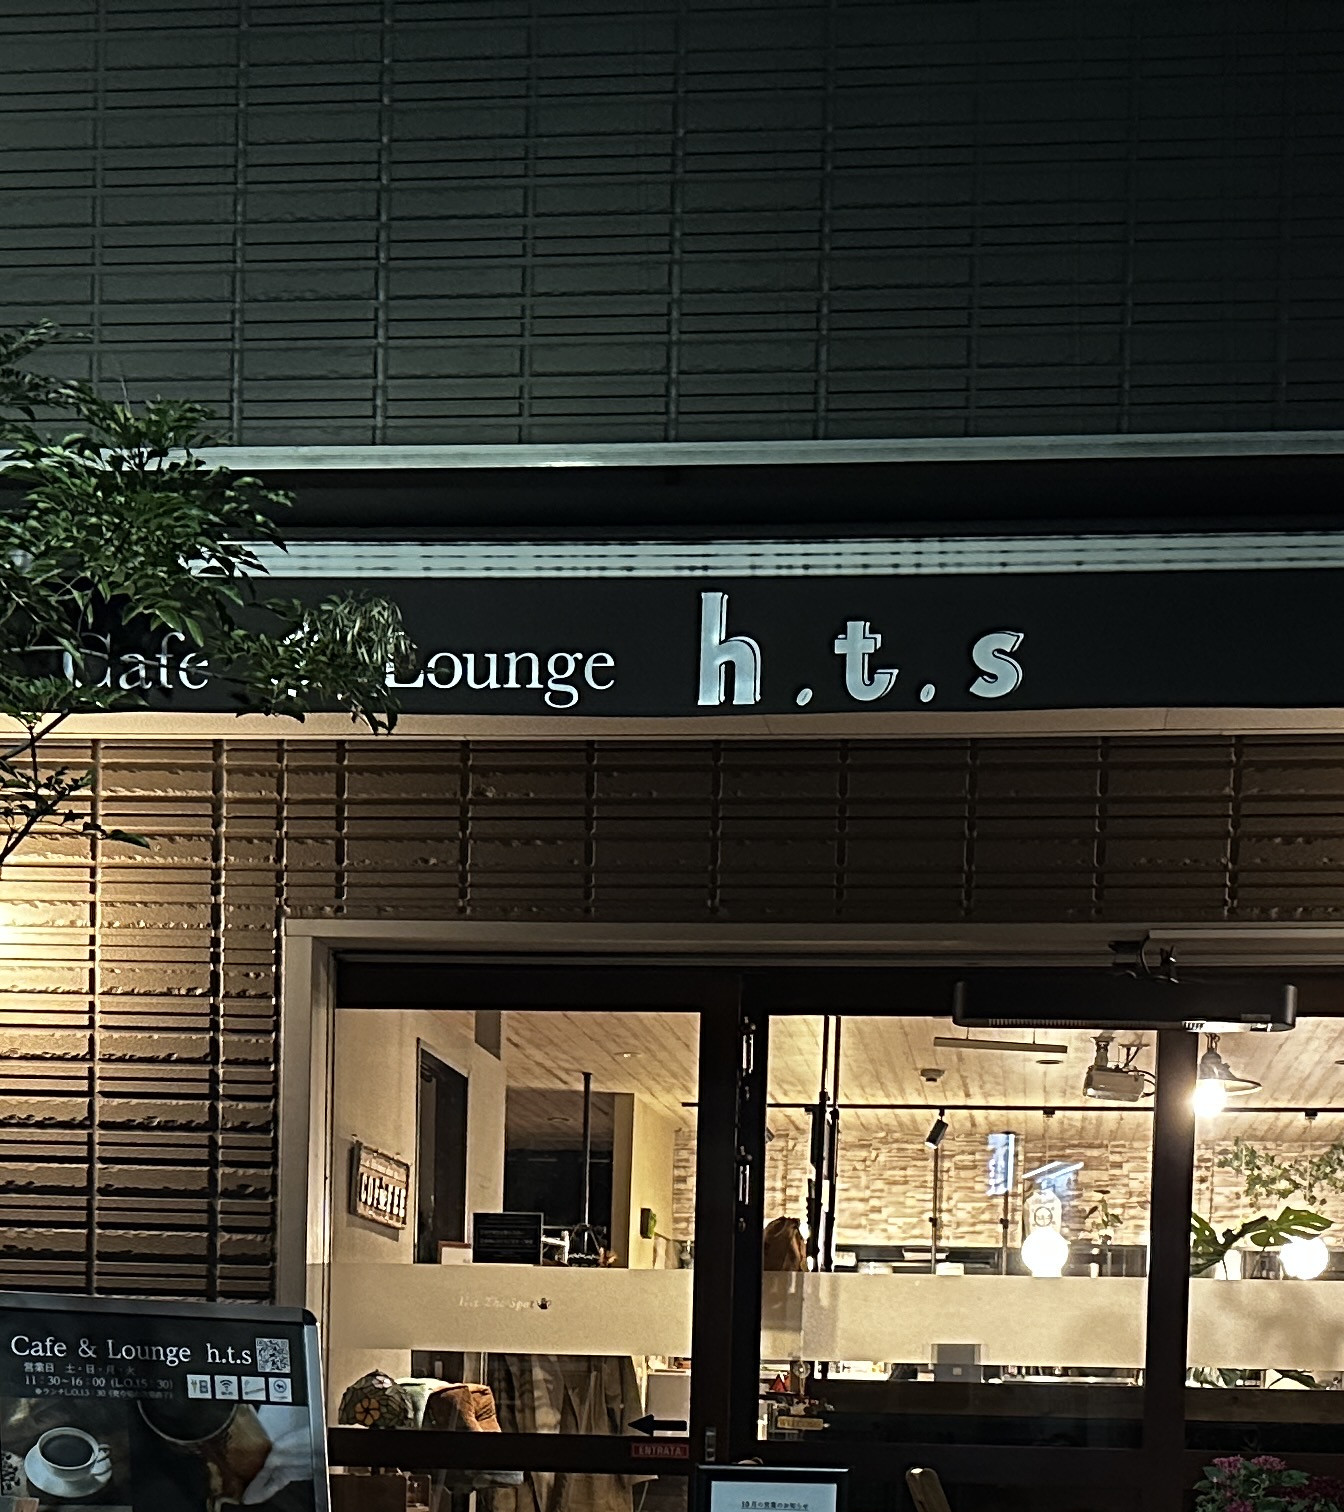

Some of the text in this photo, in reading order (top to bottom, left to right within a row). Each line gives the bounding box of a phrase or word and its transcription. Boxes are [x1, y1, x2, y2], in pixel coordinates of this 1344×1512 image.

[63, 631, 210, 691] Cafe
[385, 644, 616, 709] Lounge
[10, 1335, 253, 1367] Cafe & Lounge h.t.s
[23, 1361, 56, 1374] 営業日
[638, 1445, 682, 1456] ENTRATA
